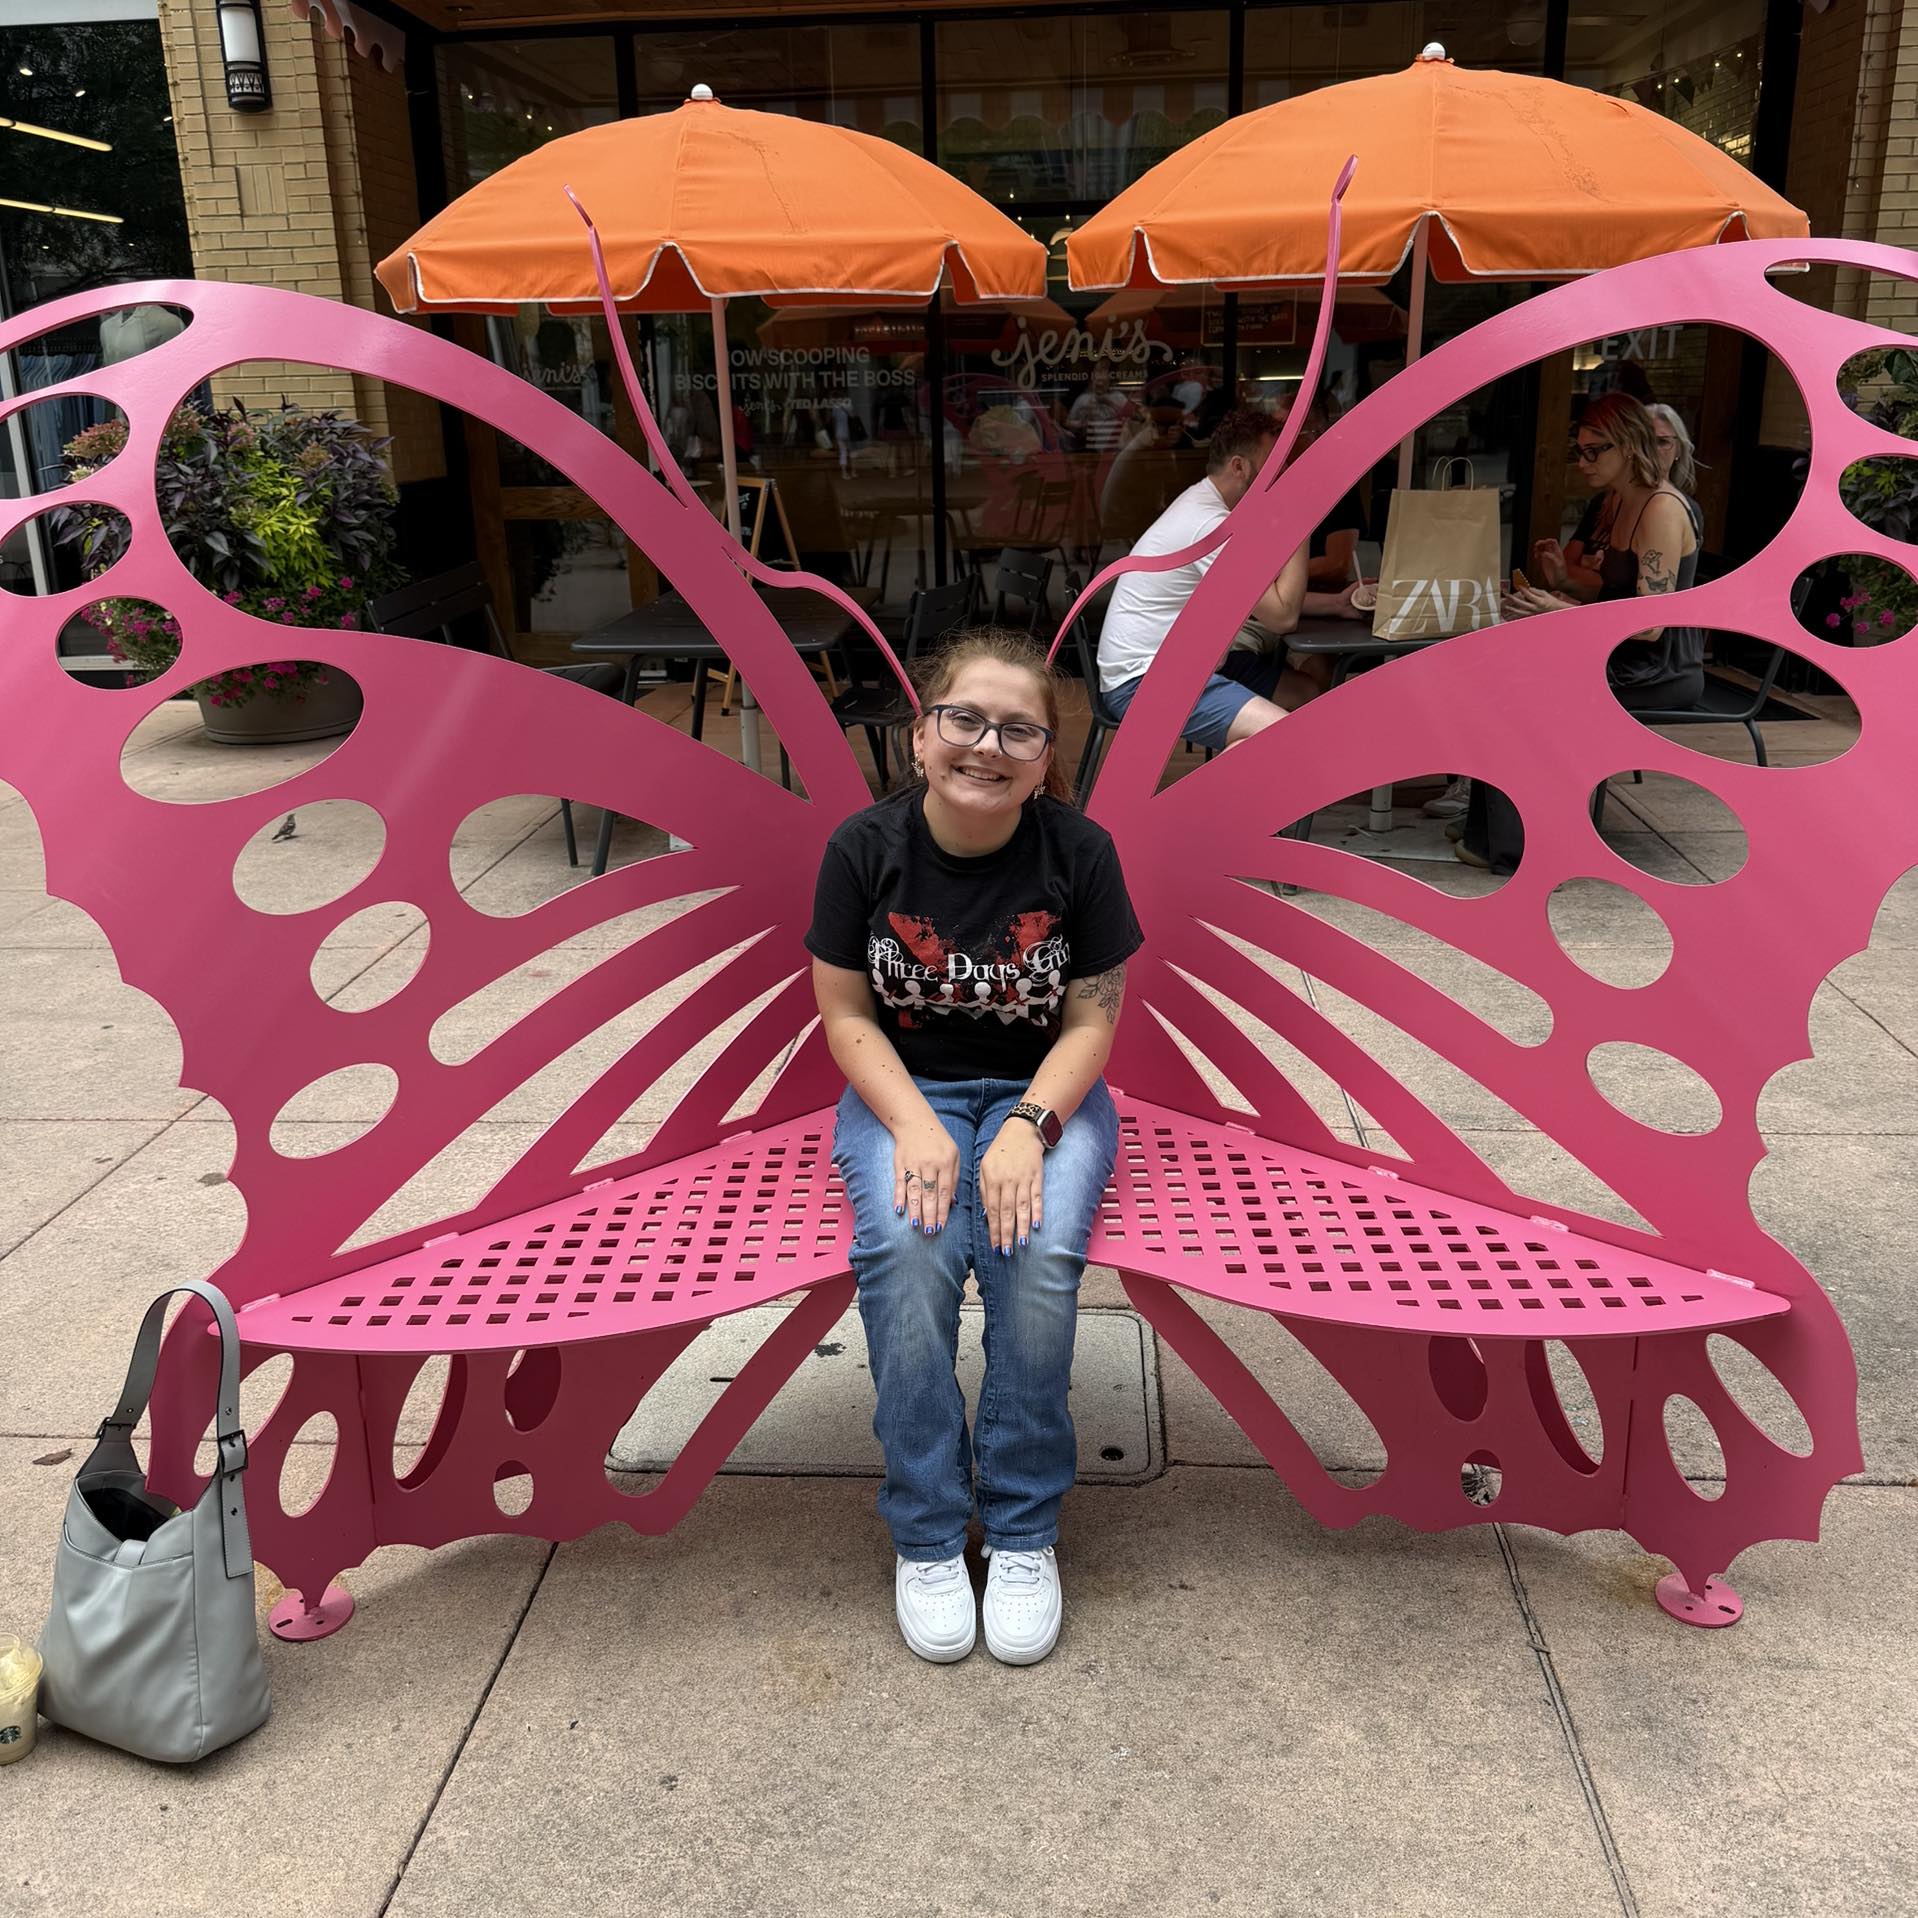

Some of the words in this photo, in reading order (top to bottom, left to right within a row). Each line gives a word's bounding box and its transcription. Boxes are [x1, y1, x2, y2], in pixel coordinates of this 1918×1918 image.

[728, 349, 764, 367] OW
[767, 345, 870, 366] SCOOPING
[991, 314, 1173, 390] jeni's
[1602, 325, 1684, 361] EXIT
[674, 371, 761, 391] BISCITS
[764, 370, 816, 390] WITH
[822, 370, 859, 389] THE
[864, 368, 916, 387] BOSS
[1041, 371, 1089, 383] SPLENDID
[1391, 576, 1501, 634] ZARA
[868, 934, 939, 982] Three
[946, 952, 1021, 992] Days
